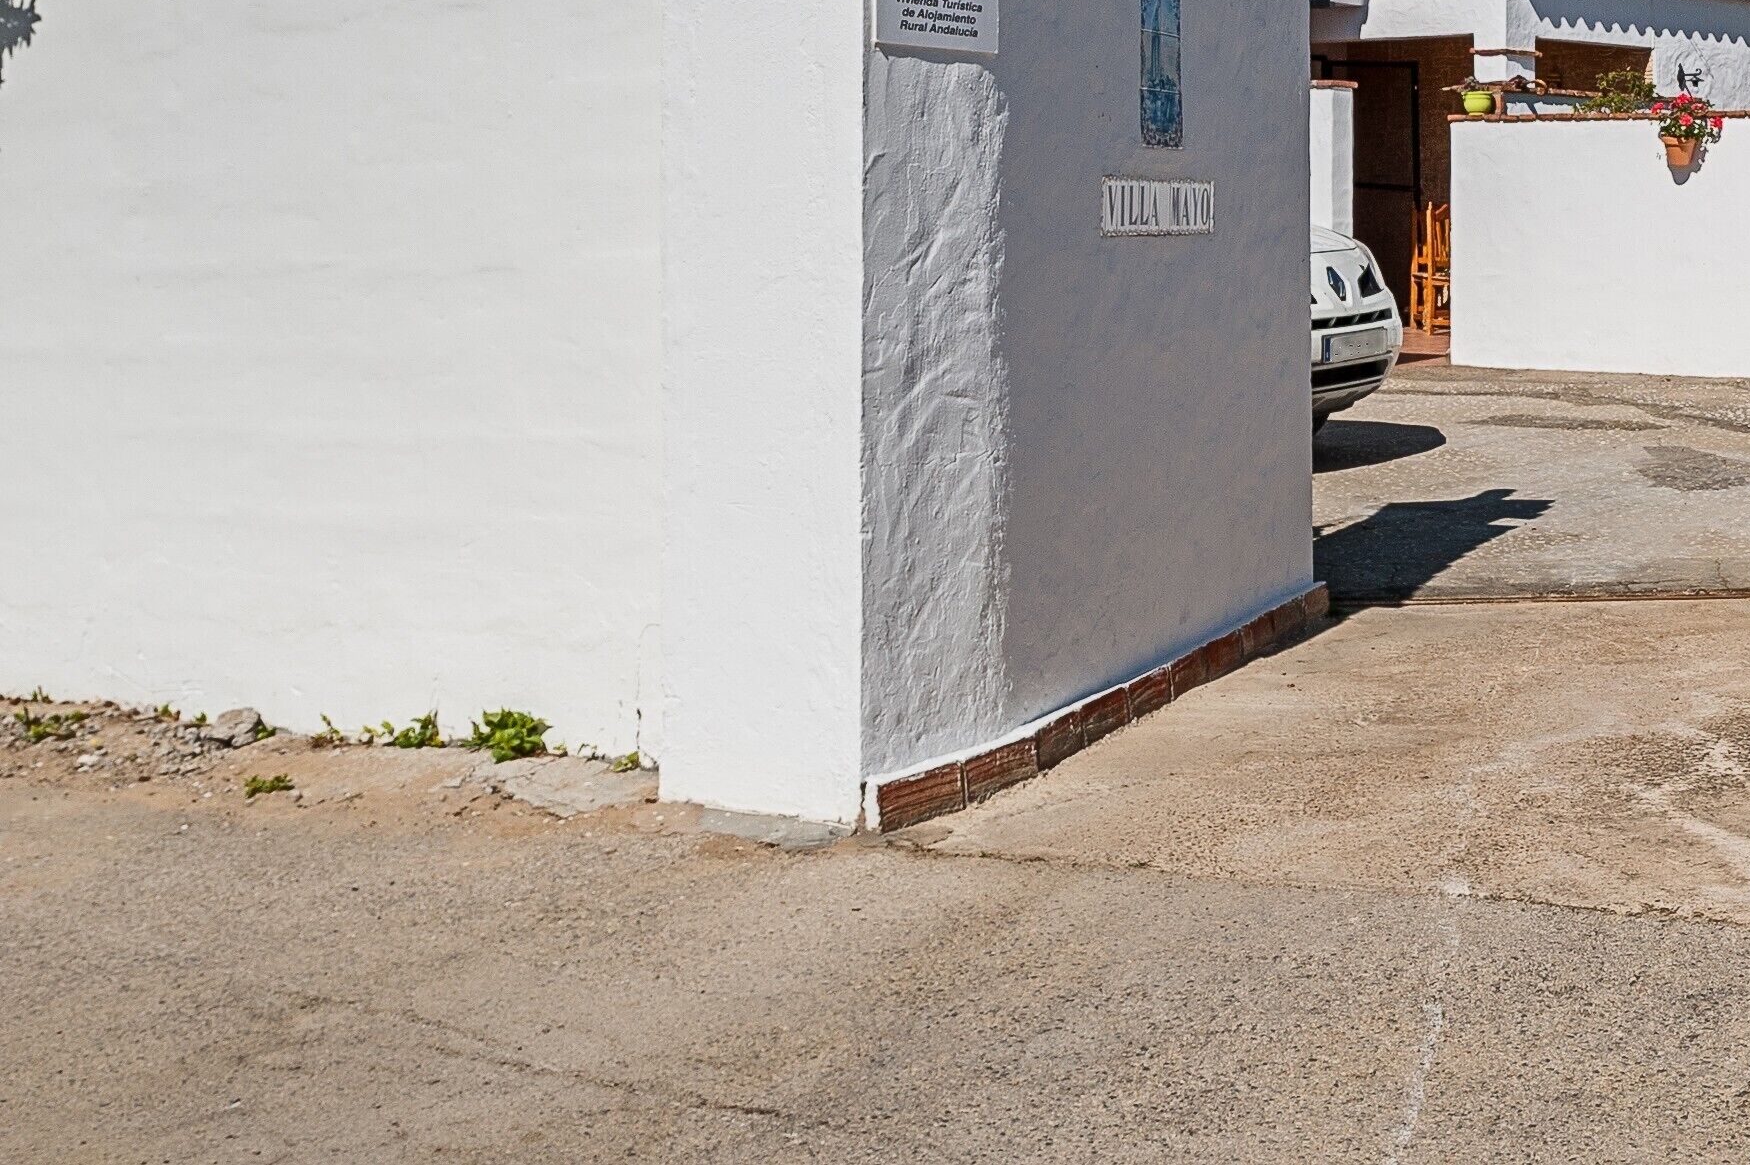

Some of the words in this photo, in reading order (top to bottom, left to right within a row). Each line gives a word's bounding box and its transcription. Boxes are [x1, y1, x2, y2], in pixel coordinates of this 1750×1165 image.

[901, 7, 916, 17] de
[916, 8, 977, 25] Alojamiento
[899, 19, 928, 32] Rural
[929, 23, 979, 38] Andalucía
[1108, 185, 1159, 227] VILLA
[1170, 186, 1211, 227] MAYO
